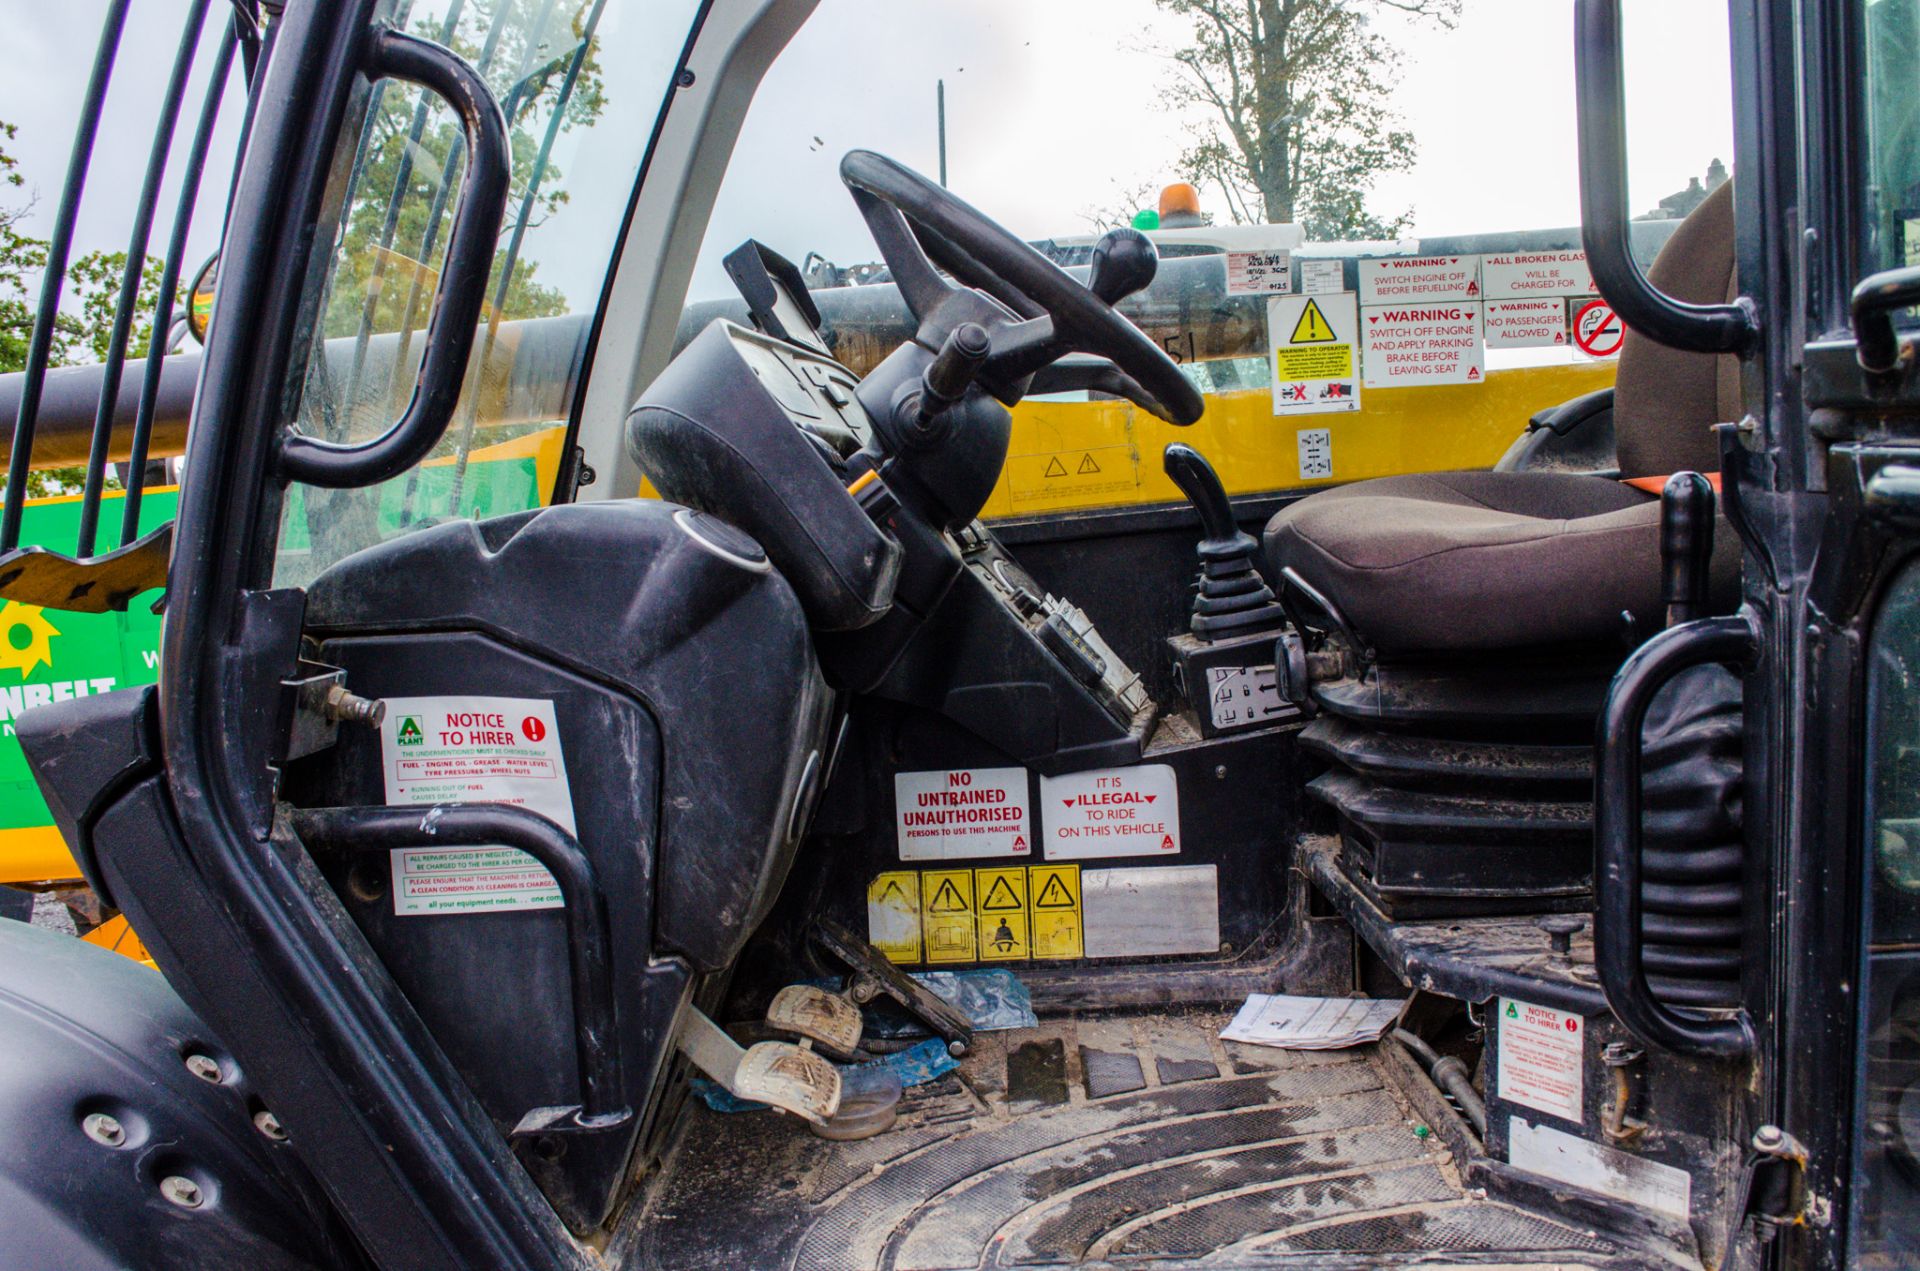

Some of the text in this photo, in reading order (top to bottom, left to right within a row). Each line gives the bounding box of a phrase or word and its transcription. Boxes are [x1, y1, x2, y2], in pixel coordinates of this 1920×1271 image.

[1392, 258, 1446, 268] WARNING
[1515, 255, 1556, 264] BROKEN
[1374, 272, 1466, 285] SWITCH ENGINE OFF
[1550, 270, 1560, 278] BE
[1377, 283, 1464, 295] BEFORE REFUELLING
[1511, 280, 1576, 290] CHARGED FOR
[1500, 302, 1548, 311] WARNING
[1383, 308, 1460, 322] WARNING
[1486, 316, 1564, 326] NO PASSENGERS
[1369, 326, 1474, 338] SWITCH OFF ENGINE
[1501, 329, 1550, 338] ALLOWED
[1372, 338, 1474, 350] AND APPLY PARKING
[1386, 352, 1460, 362] BRAKE BEFORE
[1389, 364, 1458, 376] LEAVING SEAT
[447, 714, 505, 728] NOTICE
[398, 738, 424, 746] PLANT
[439, 731, 516, 746] TO HIRER
[950, 772, 972, 786] NO
[1096, 778, 1122, 788] IT IS
[918, 789, 1006, 806] UNTRAINED
[1078, 792, 1144, 806] ILLEGAL
[904, 806, 1022, 826] UNAUTHORISED
[1086, 808, 1136, 820] TO RIDE
[907, 828, 940, 838] PERSONS
[988, 824, 1020, 832] MACHINE
[1058, 823, 1164, 838] ON THIS VEHICLE
[440, 900, 455, 909] your
[456, 900, 494, 908] equipment
[1528, 1007, 1556, 1020] NOTICE
[1524, 1015, 1560, 1032] TO HIRER
